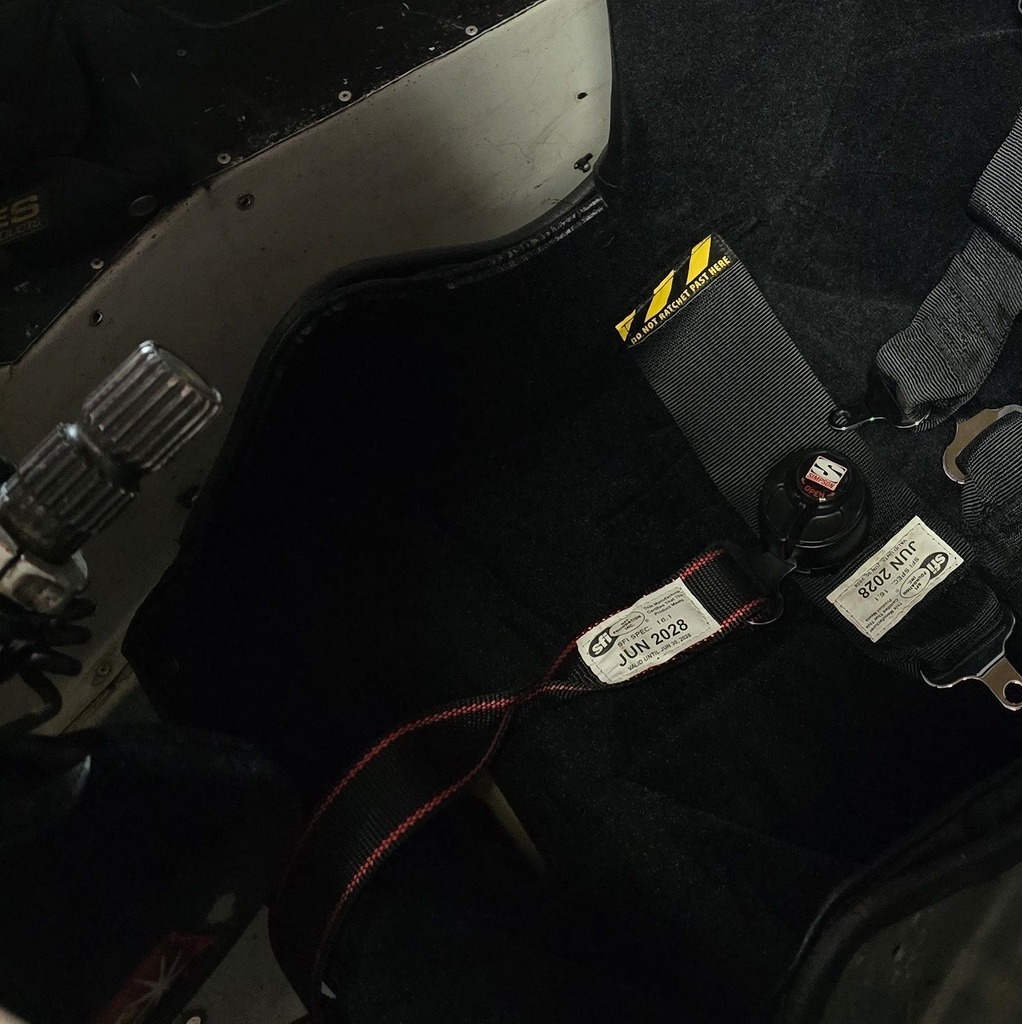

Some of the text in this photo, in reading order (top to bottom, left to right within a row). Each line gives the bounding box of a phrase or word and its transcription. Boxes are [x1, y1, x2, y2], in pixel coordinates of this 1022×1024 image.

[641, 317, 658, 335] NOT
[658, 289, 691, 321] RATCHET
[689, 272, 709, 293] PAST
[707, 255, 731, 276] HERE
[808, 471, 836, 489] SIMPSON
[803, 484, 826, 499] OPEN
[858, 541, 916, 598] JUN 2028
[909, 557, 919, 568] SFI
[618, 638, 629, 647] SFI
[630, 626, 652, 639] SPEC.
[619, 619, 688, 666] JUN 2028
[627, 660, 643, 670] VALID
